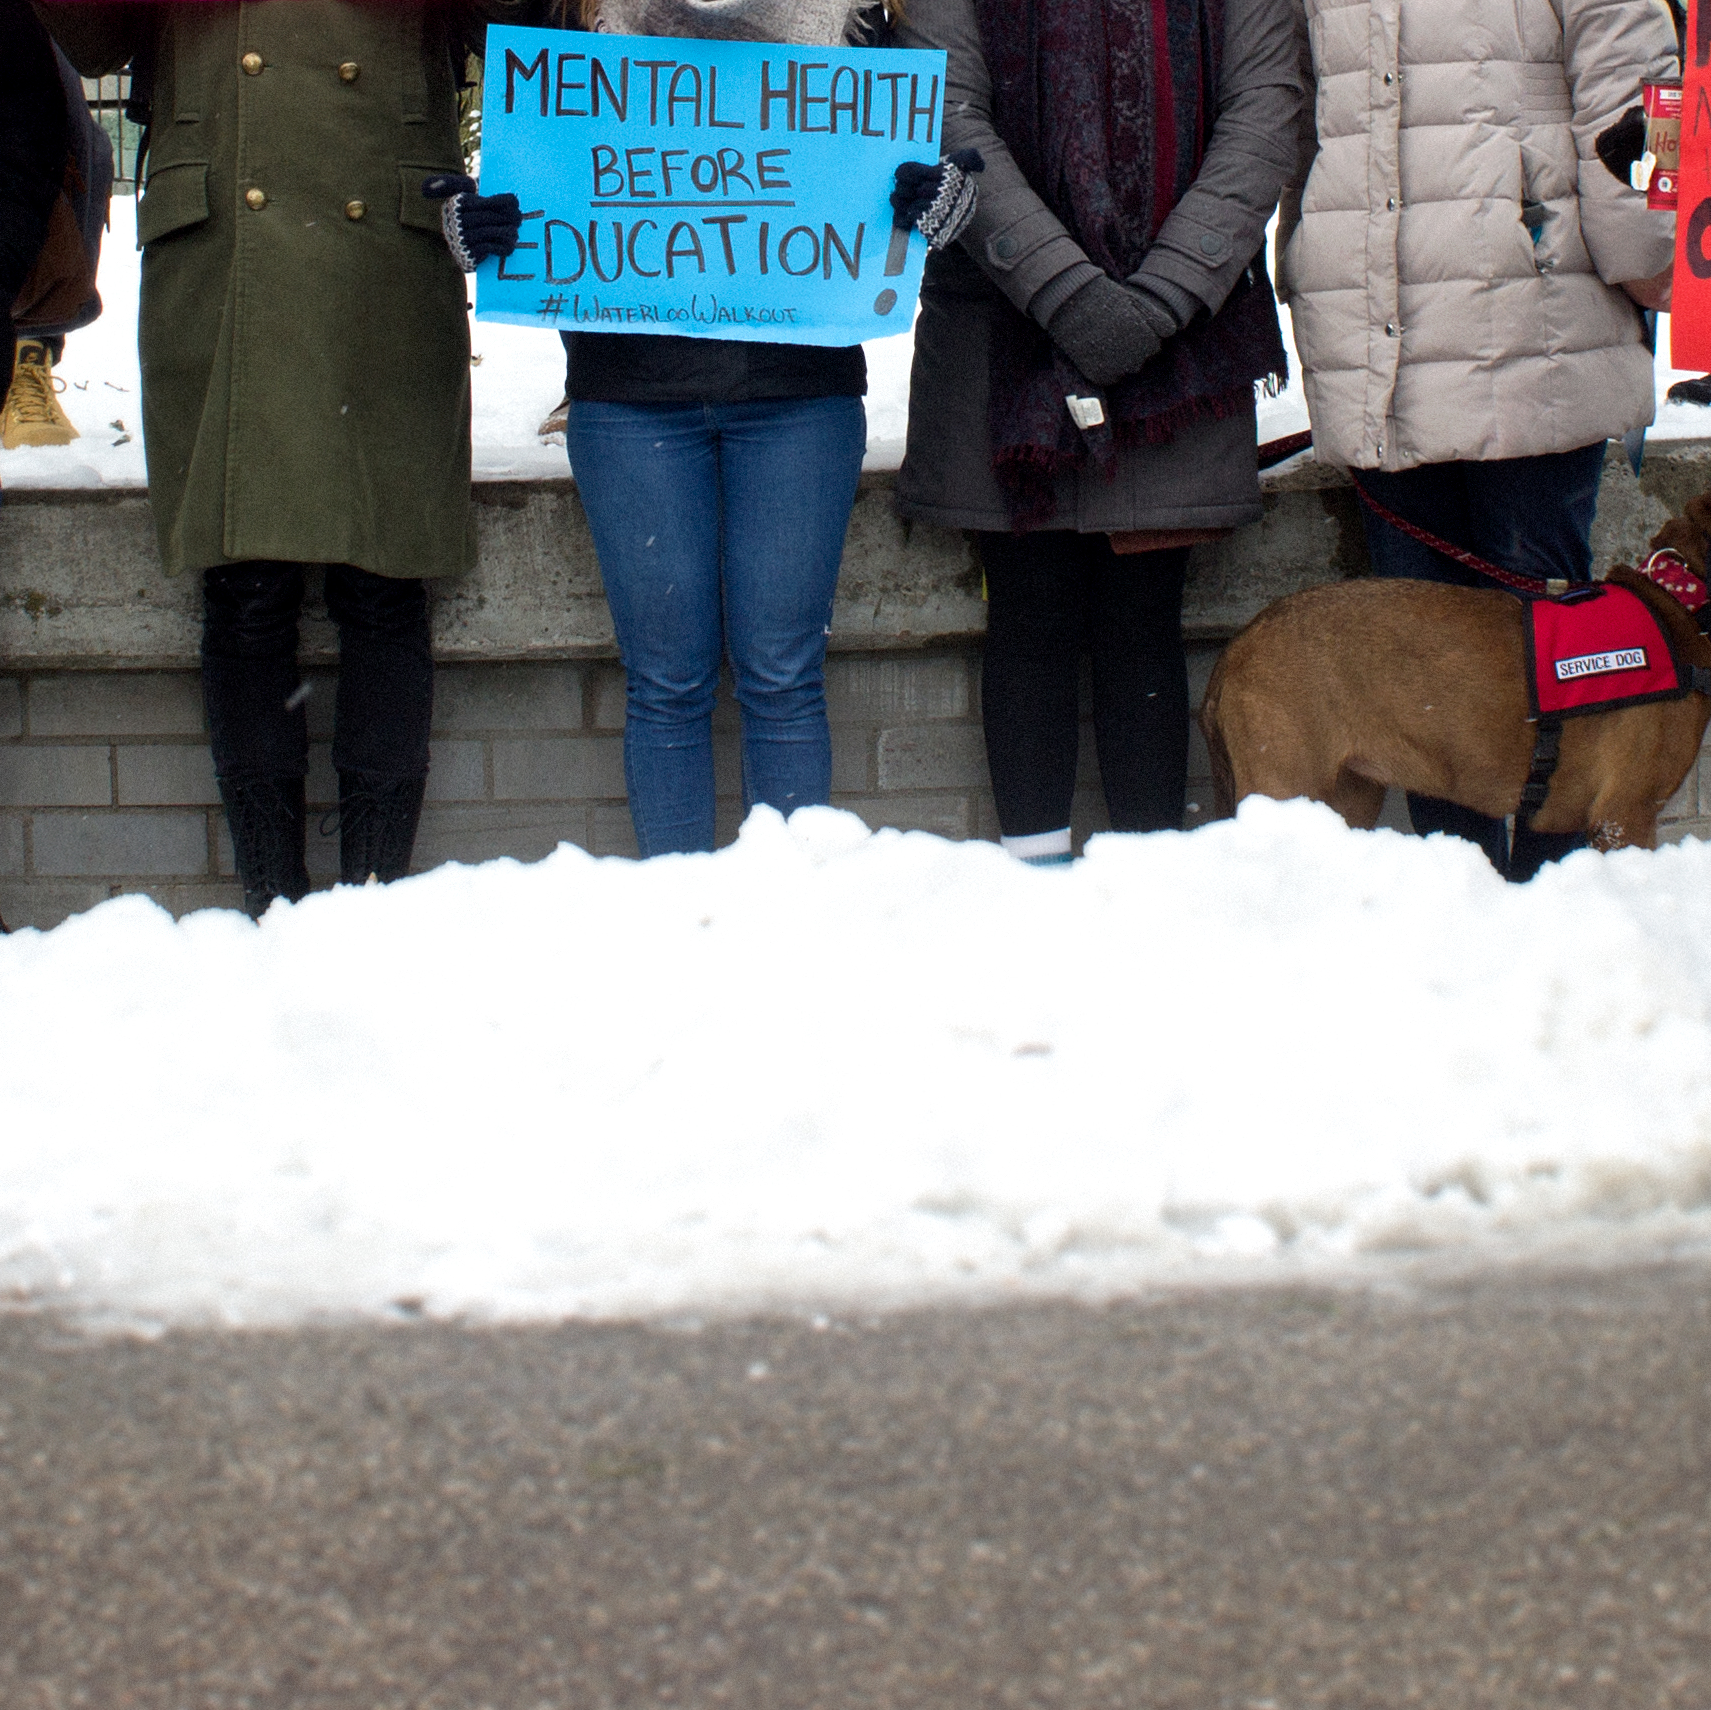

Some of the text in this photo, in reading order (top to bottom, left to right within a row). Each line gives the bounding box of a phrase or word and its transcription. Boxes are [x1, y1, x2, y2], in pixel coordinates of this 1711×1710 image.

[505, 47, 938, 144] MENTAL HEALTH
[592, 144, 791, 198] BEFORE
[1559, 651, 1642, 677] SERVICE DOG
